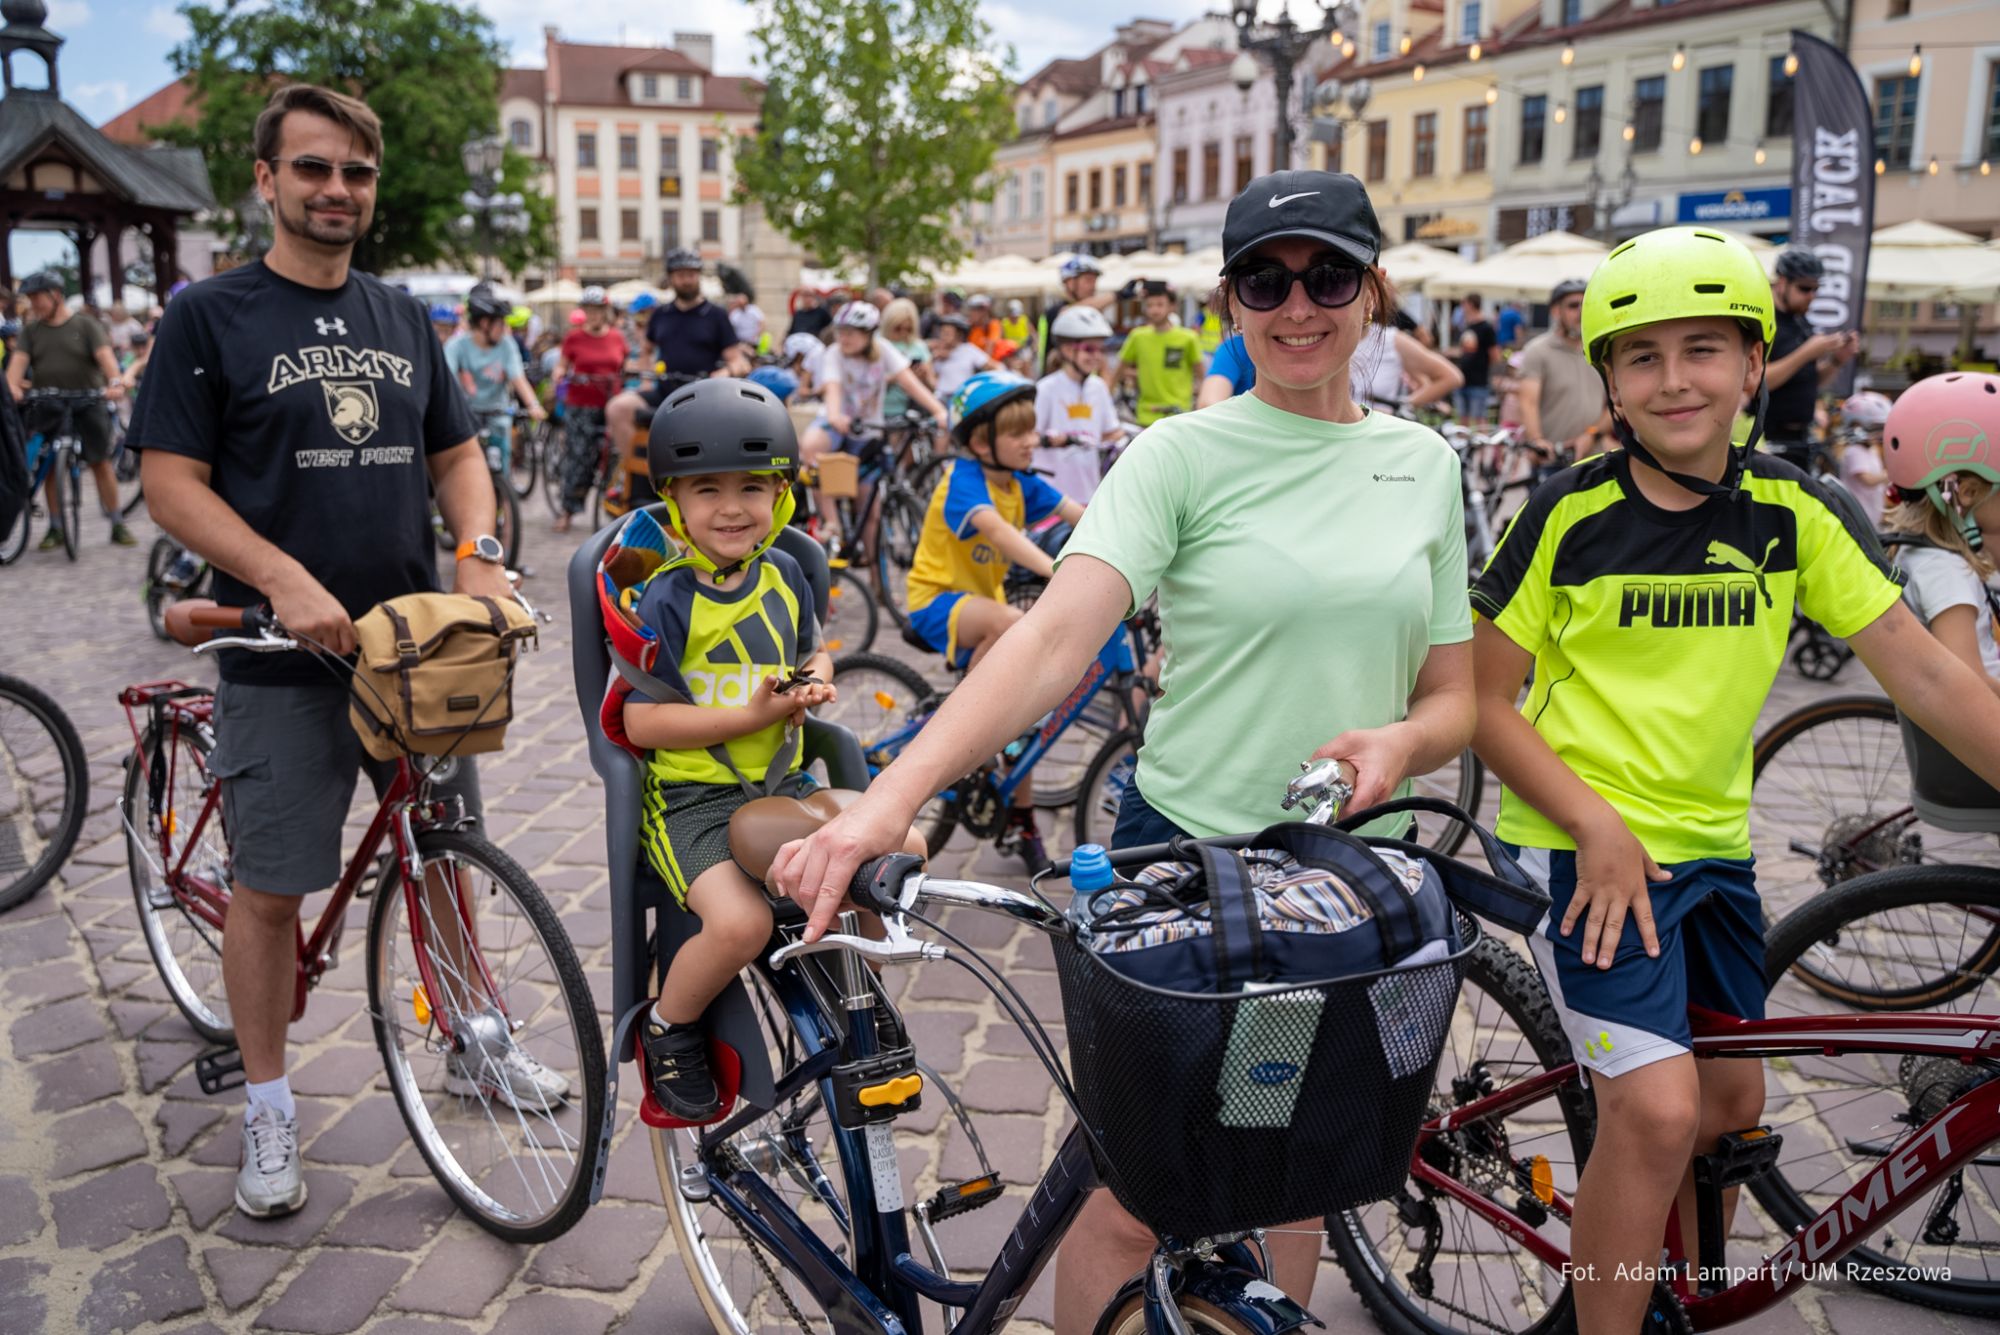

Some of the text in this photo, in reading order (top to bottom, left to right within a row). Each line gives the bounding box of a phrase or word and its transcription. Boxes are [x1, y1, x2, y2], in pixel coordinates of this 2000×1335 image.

[267, 345, 413, 394] ARMY
[296, 447, 414, 468] WEST POINT
[1618, 581, 1756, 628] PUMA
[1771, 1102, 1971, 1292] ROMET
